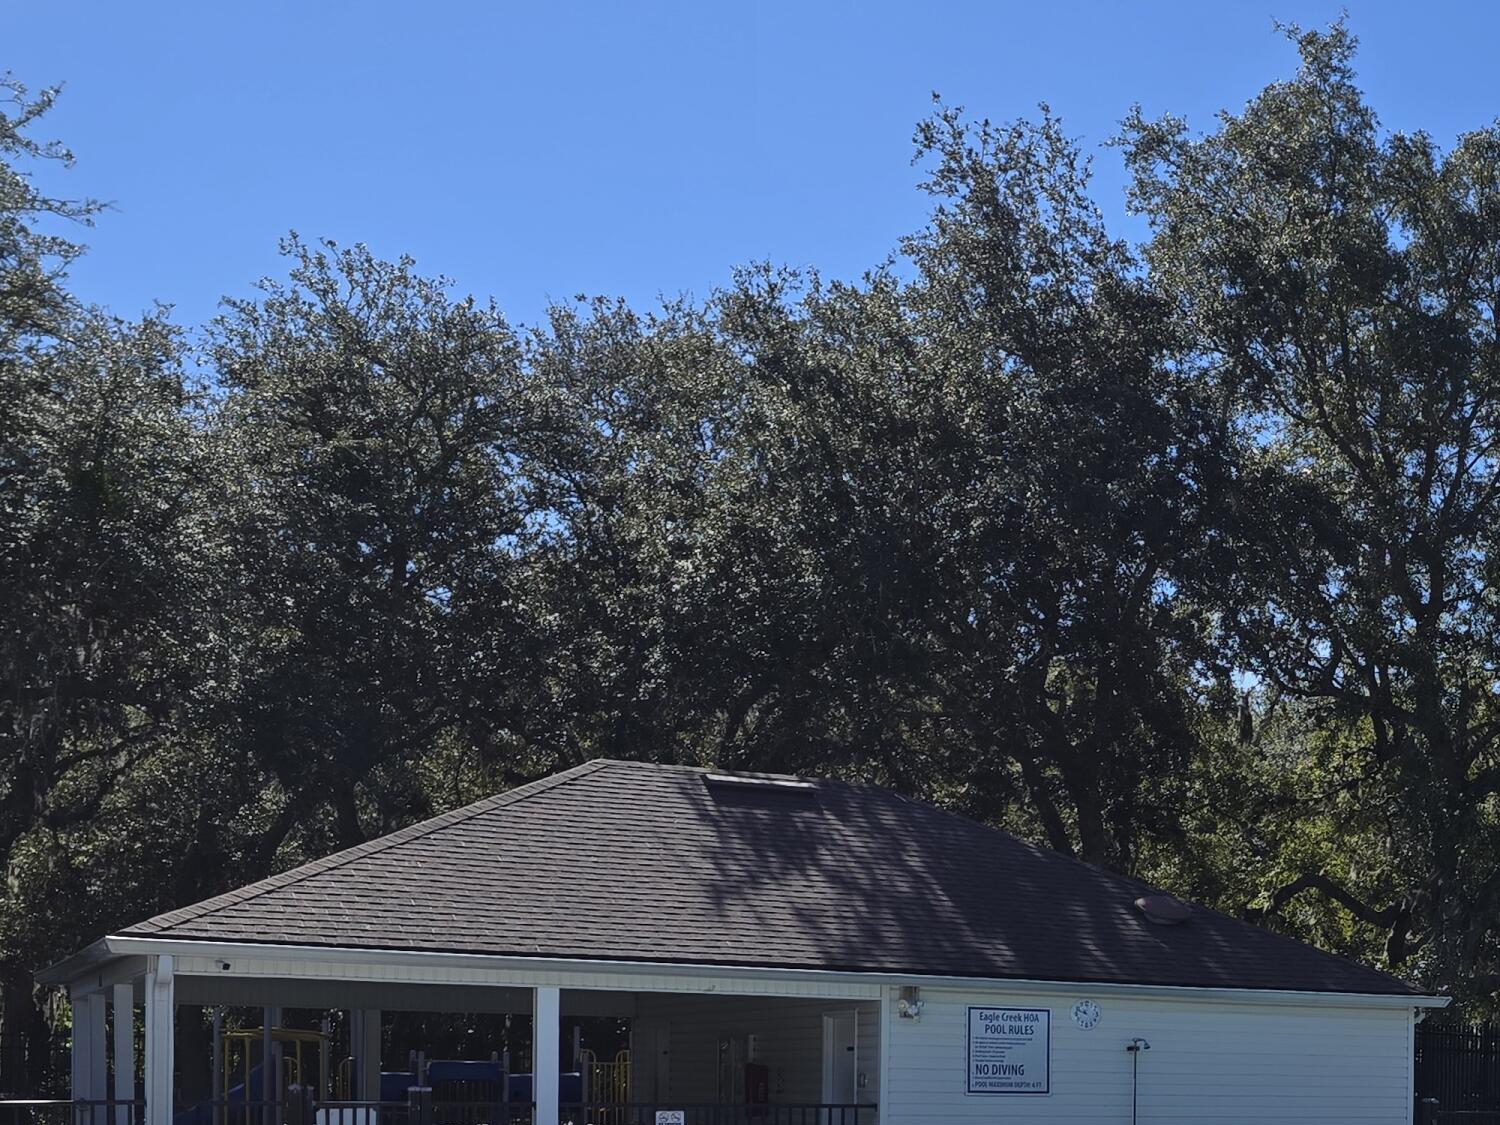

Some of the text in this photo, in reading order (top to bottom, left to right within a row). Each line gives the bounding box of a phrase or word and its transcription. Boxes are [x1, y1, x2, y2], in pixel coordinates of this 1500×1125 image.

[979, 1012, 1040, 1023] Eagle Creek HOA
[985, 1024, 1034, 1036] POOL RULES
[975, 1063, 1025, 1076] NO DIVING
